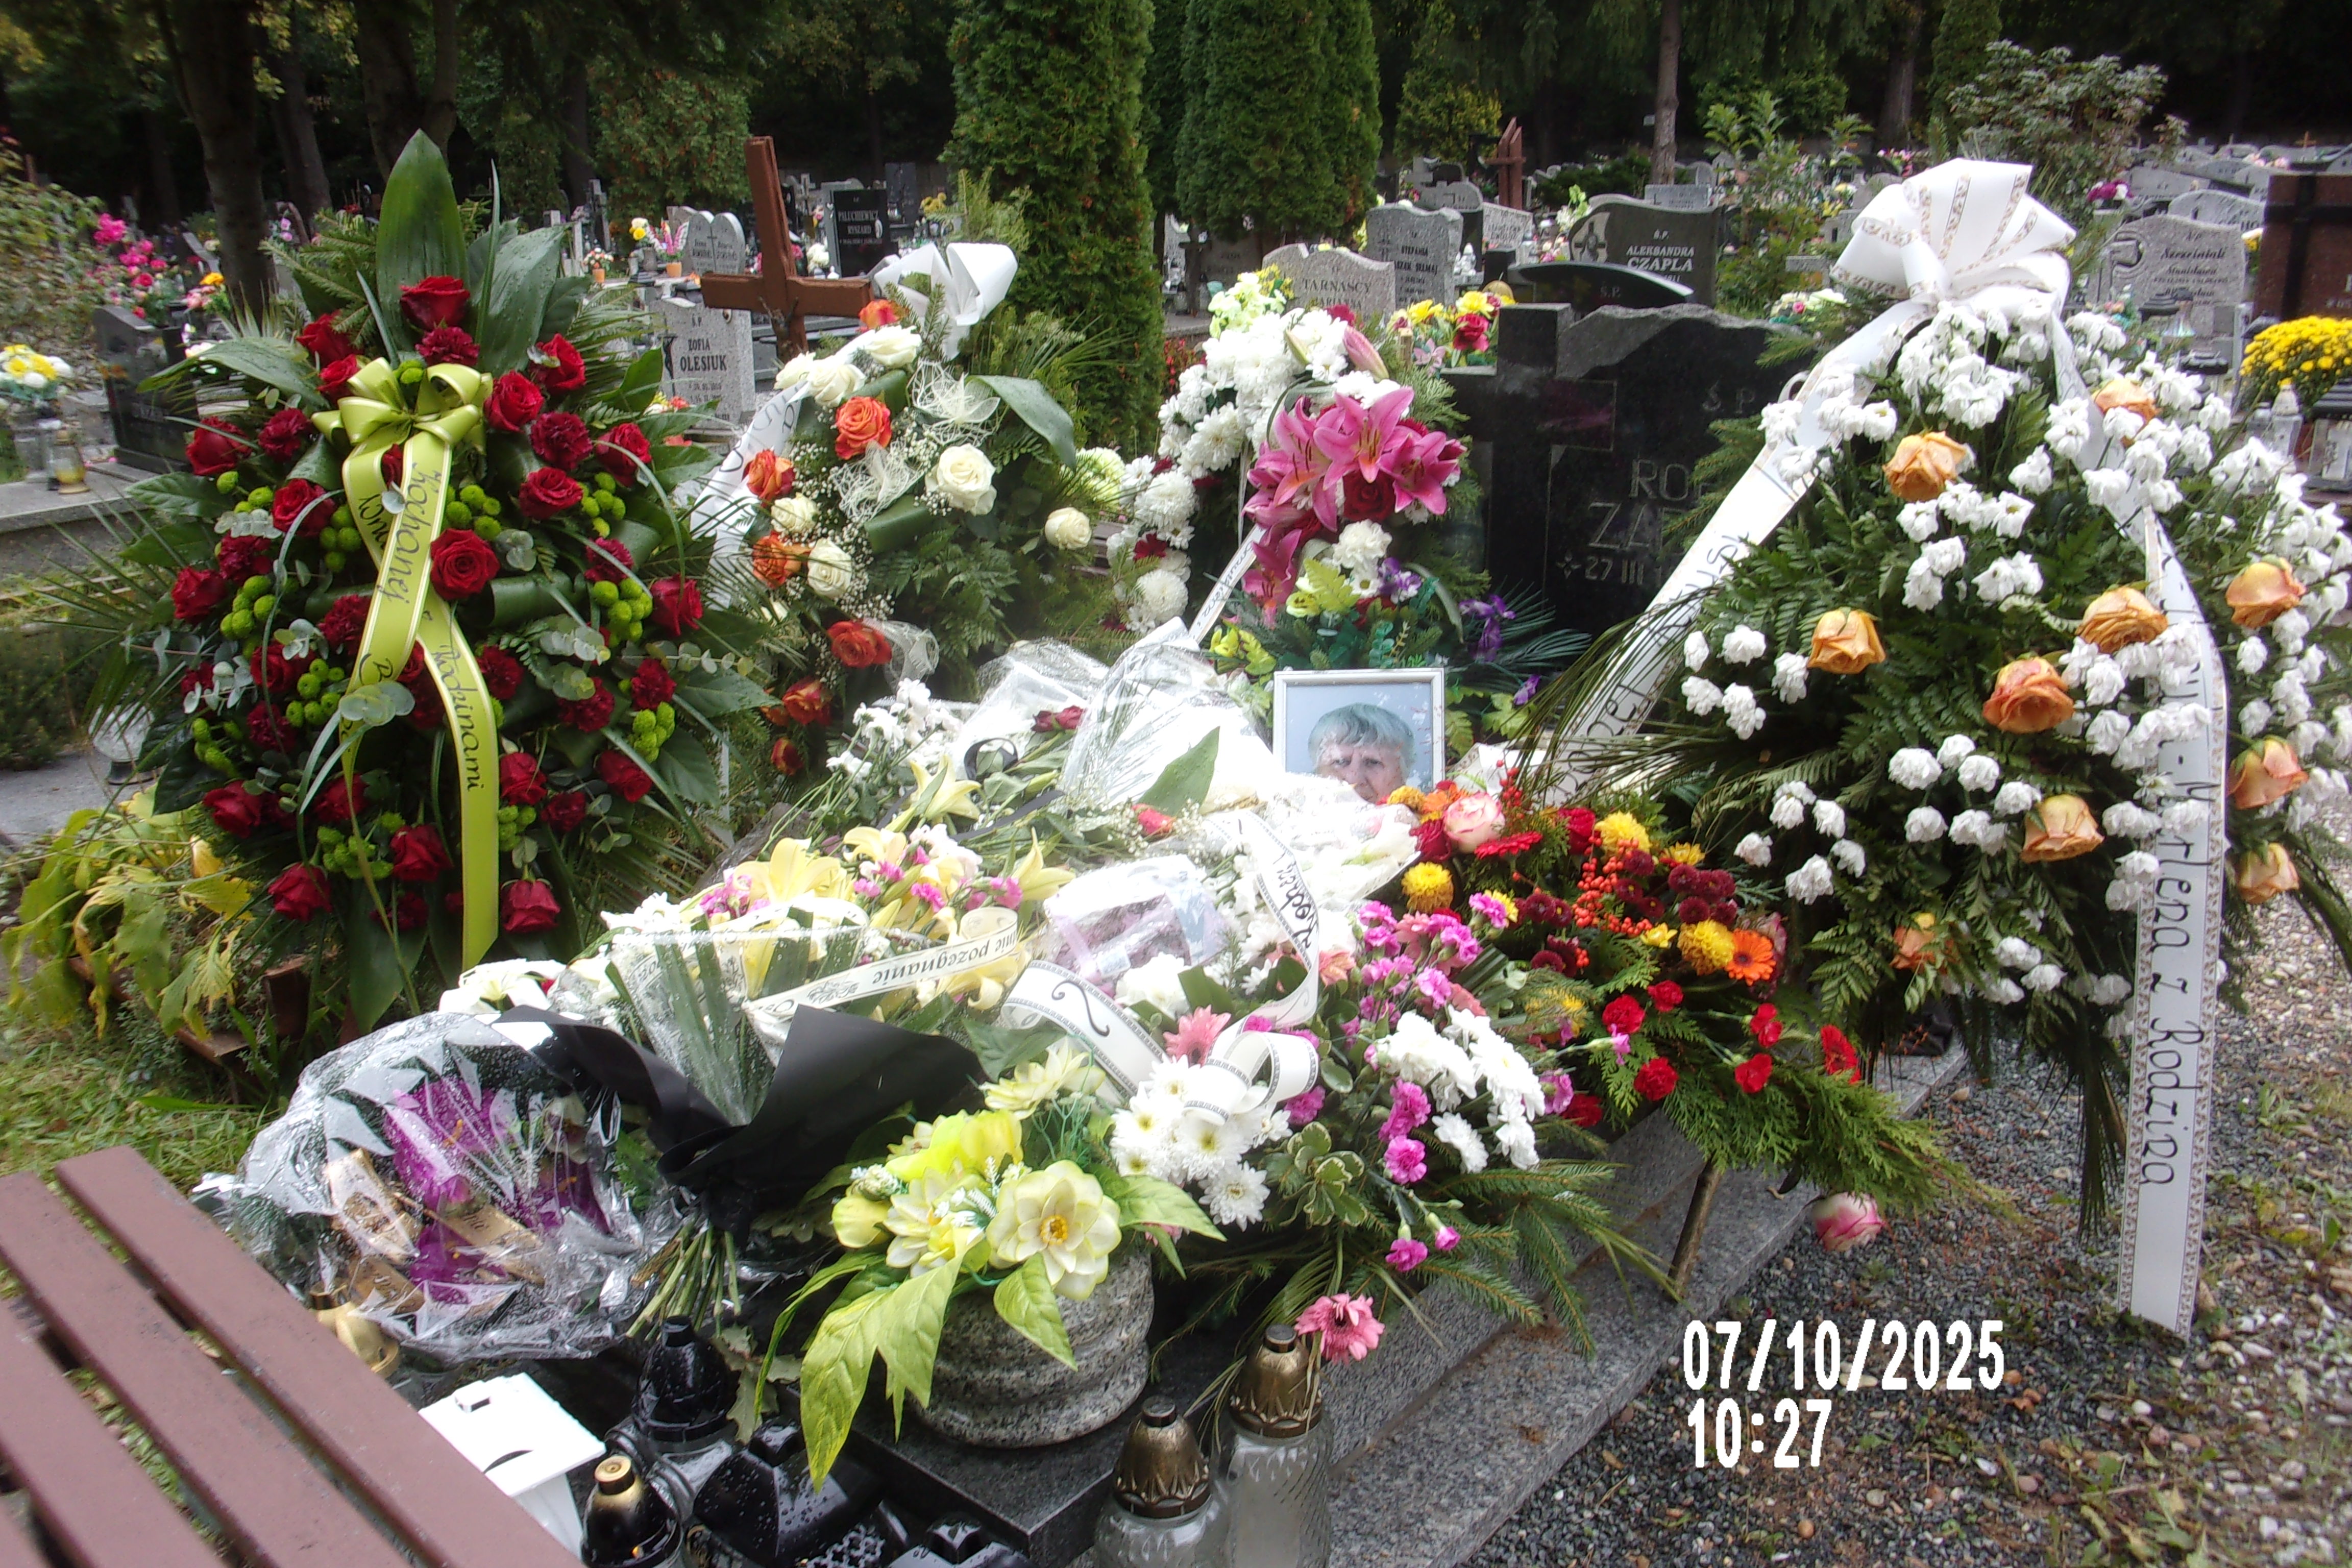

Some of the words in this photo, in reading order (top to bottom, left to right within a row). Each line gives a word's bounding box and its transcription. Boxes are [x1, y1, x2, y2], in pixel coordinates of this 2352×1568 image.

[1626, 245, 1695, 256] ALEKSANDRA
[688, 338, 710, 351] ZOFIA
[679, 354, 727, 372] OLESIUK
[1585, 555, 1613, 581] 27
